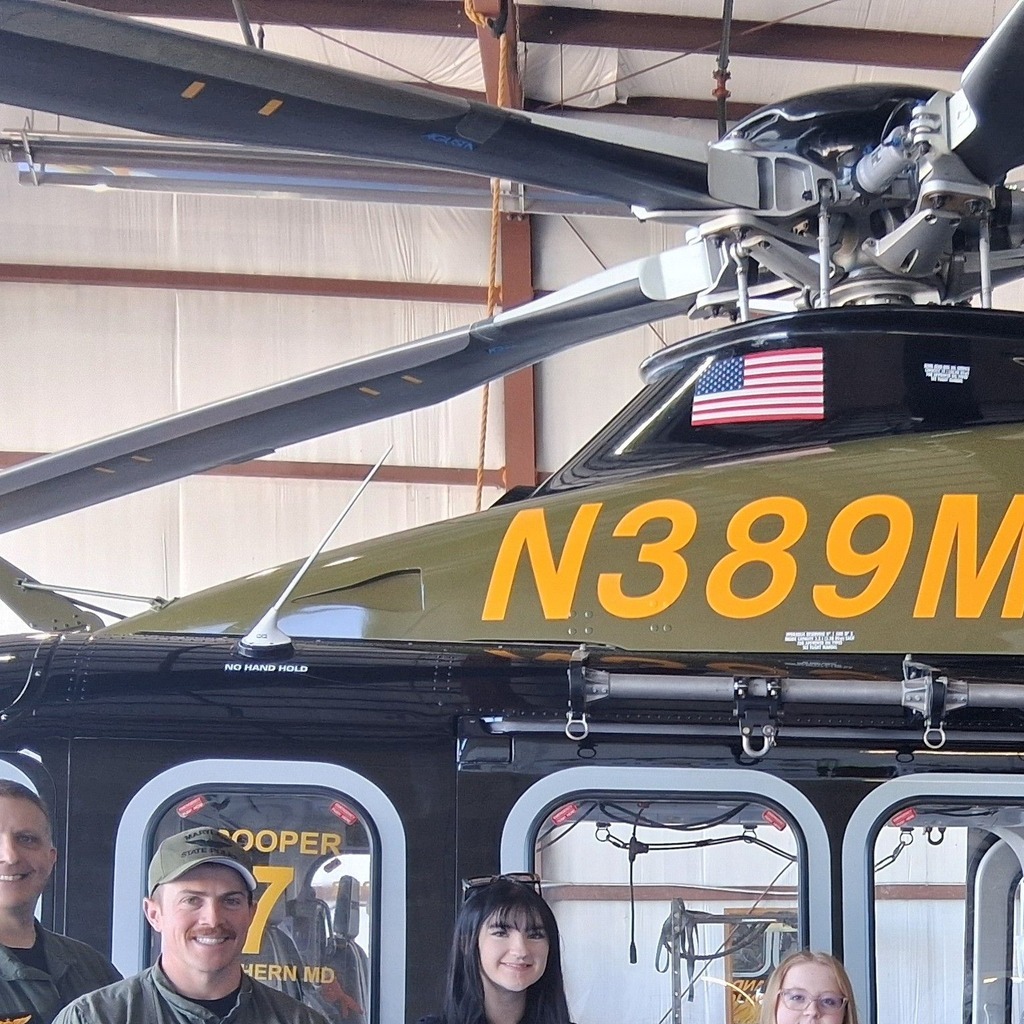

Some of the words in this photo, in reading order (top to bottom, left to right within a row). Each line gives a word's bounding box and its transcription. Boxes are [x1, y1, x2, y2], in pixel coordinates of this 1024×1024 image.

[224, 663, 242, 671] NO
[244, 664, 276, 672] HAND
[278, 665, 309, 673] HOLD
[218, 829, 342, 856] OOPER
[241, 865, 295, 955] 7
[241, 964, 297, 982] HERN
[303, 966, 335, 984] MD
